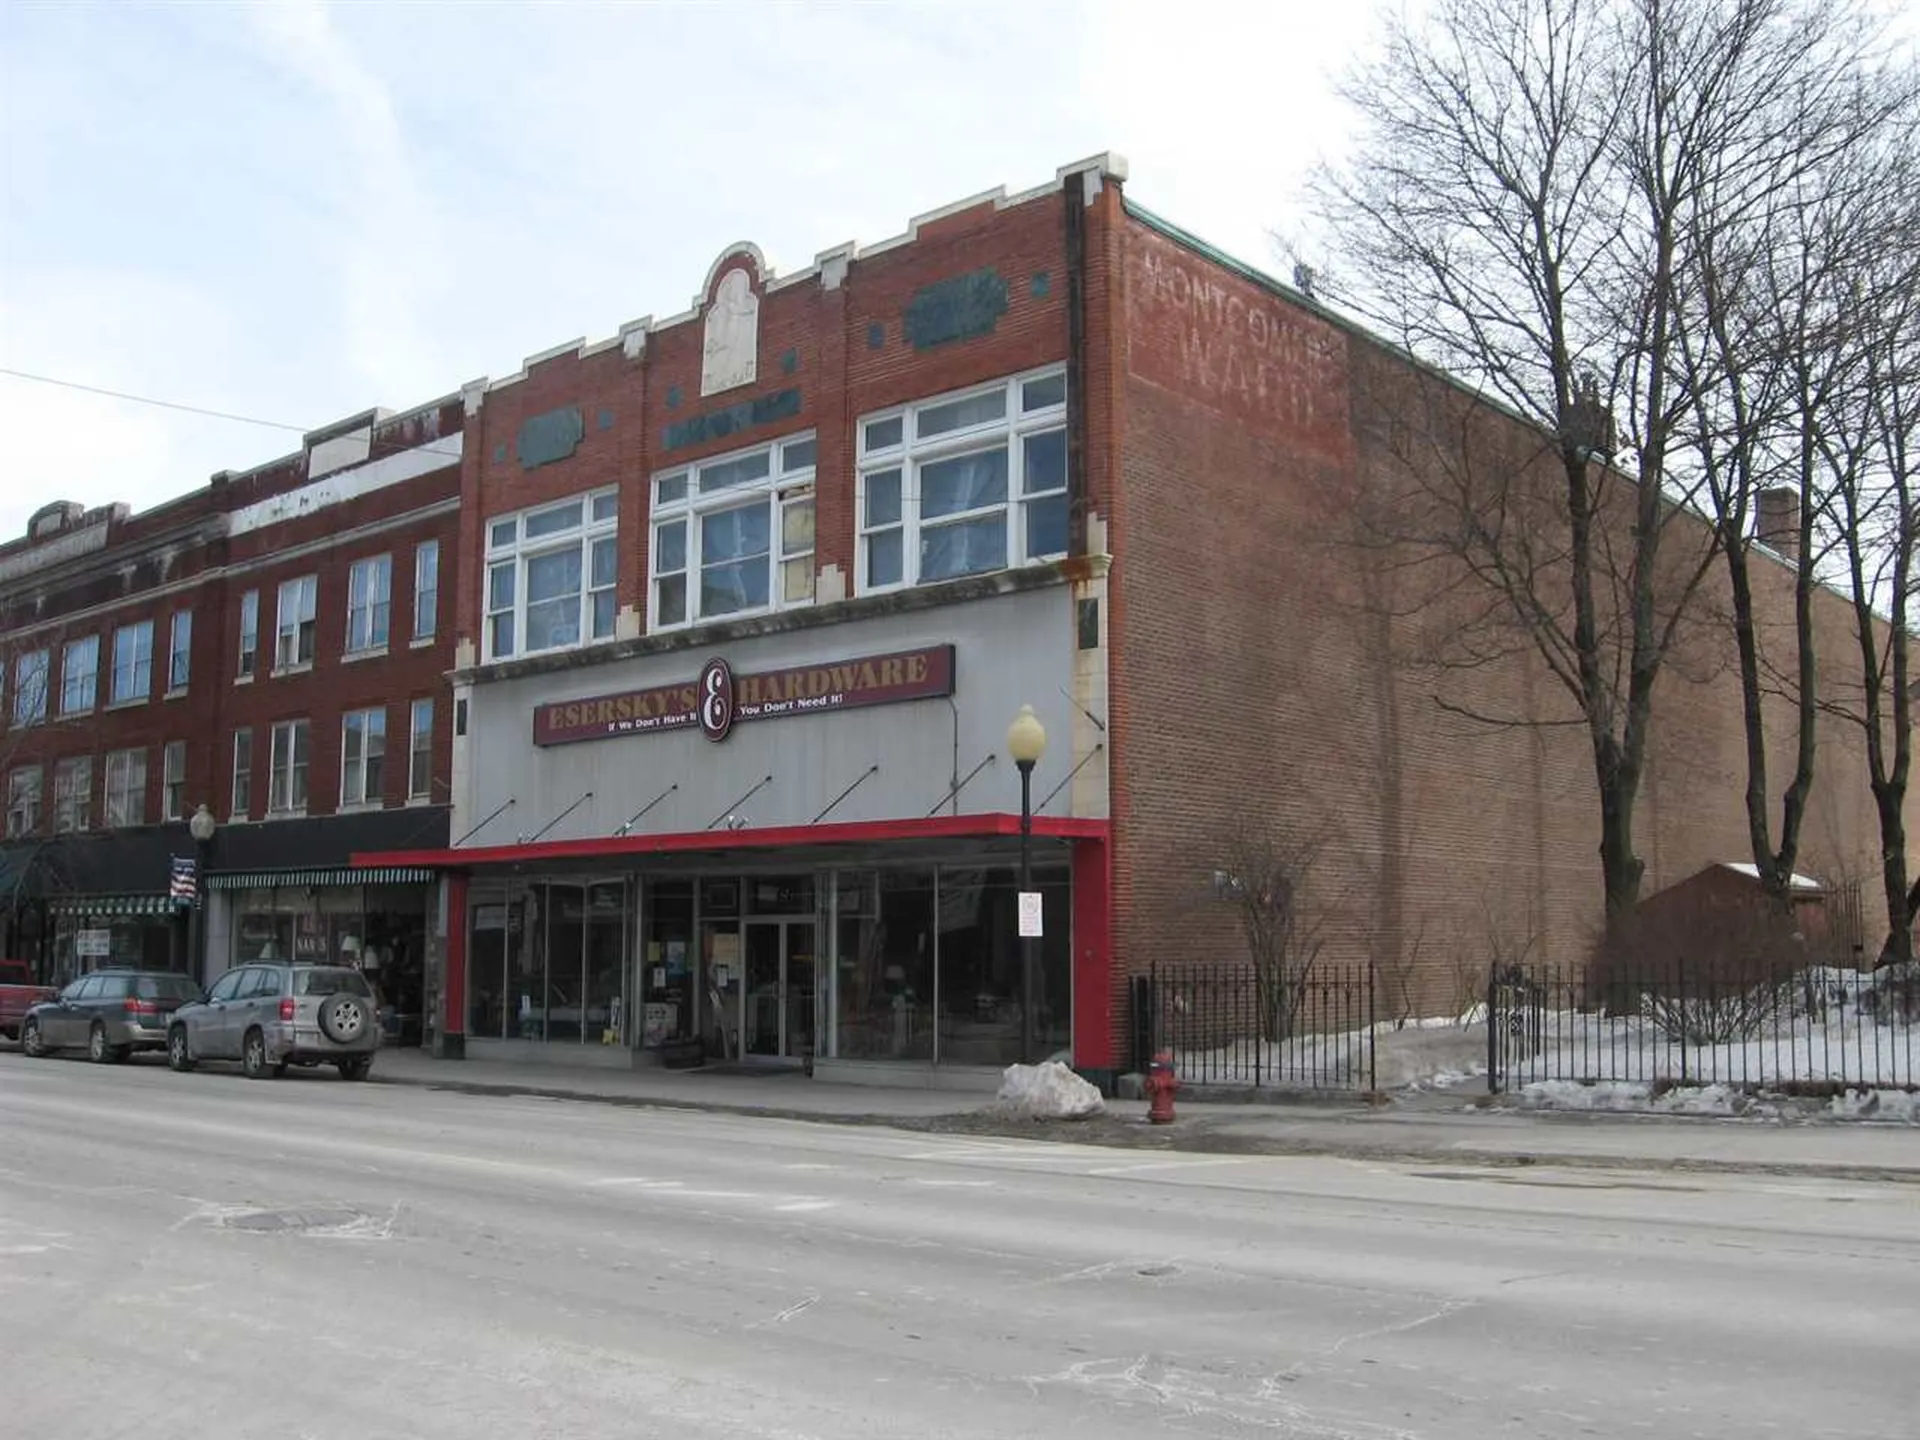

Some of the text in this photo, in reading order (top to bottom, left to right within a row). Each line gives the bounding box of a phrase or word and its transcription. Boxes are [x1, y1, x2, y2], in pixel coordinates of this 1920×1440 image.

[549, 687, 697, 729] ESERSKY'S
[739, 655, 928, 705] HARDWARE
[619, 720, 632, 729] We
[635, 716, 660, 728] Don't
[663, 714, 686, 724] Have
[740, 705, 760, 715] You
[764, 700, 794, 712] Don't
[798, 695, 827, 707] Need
